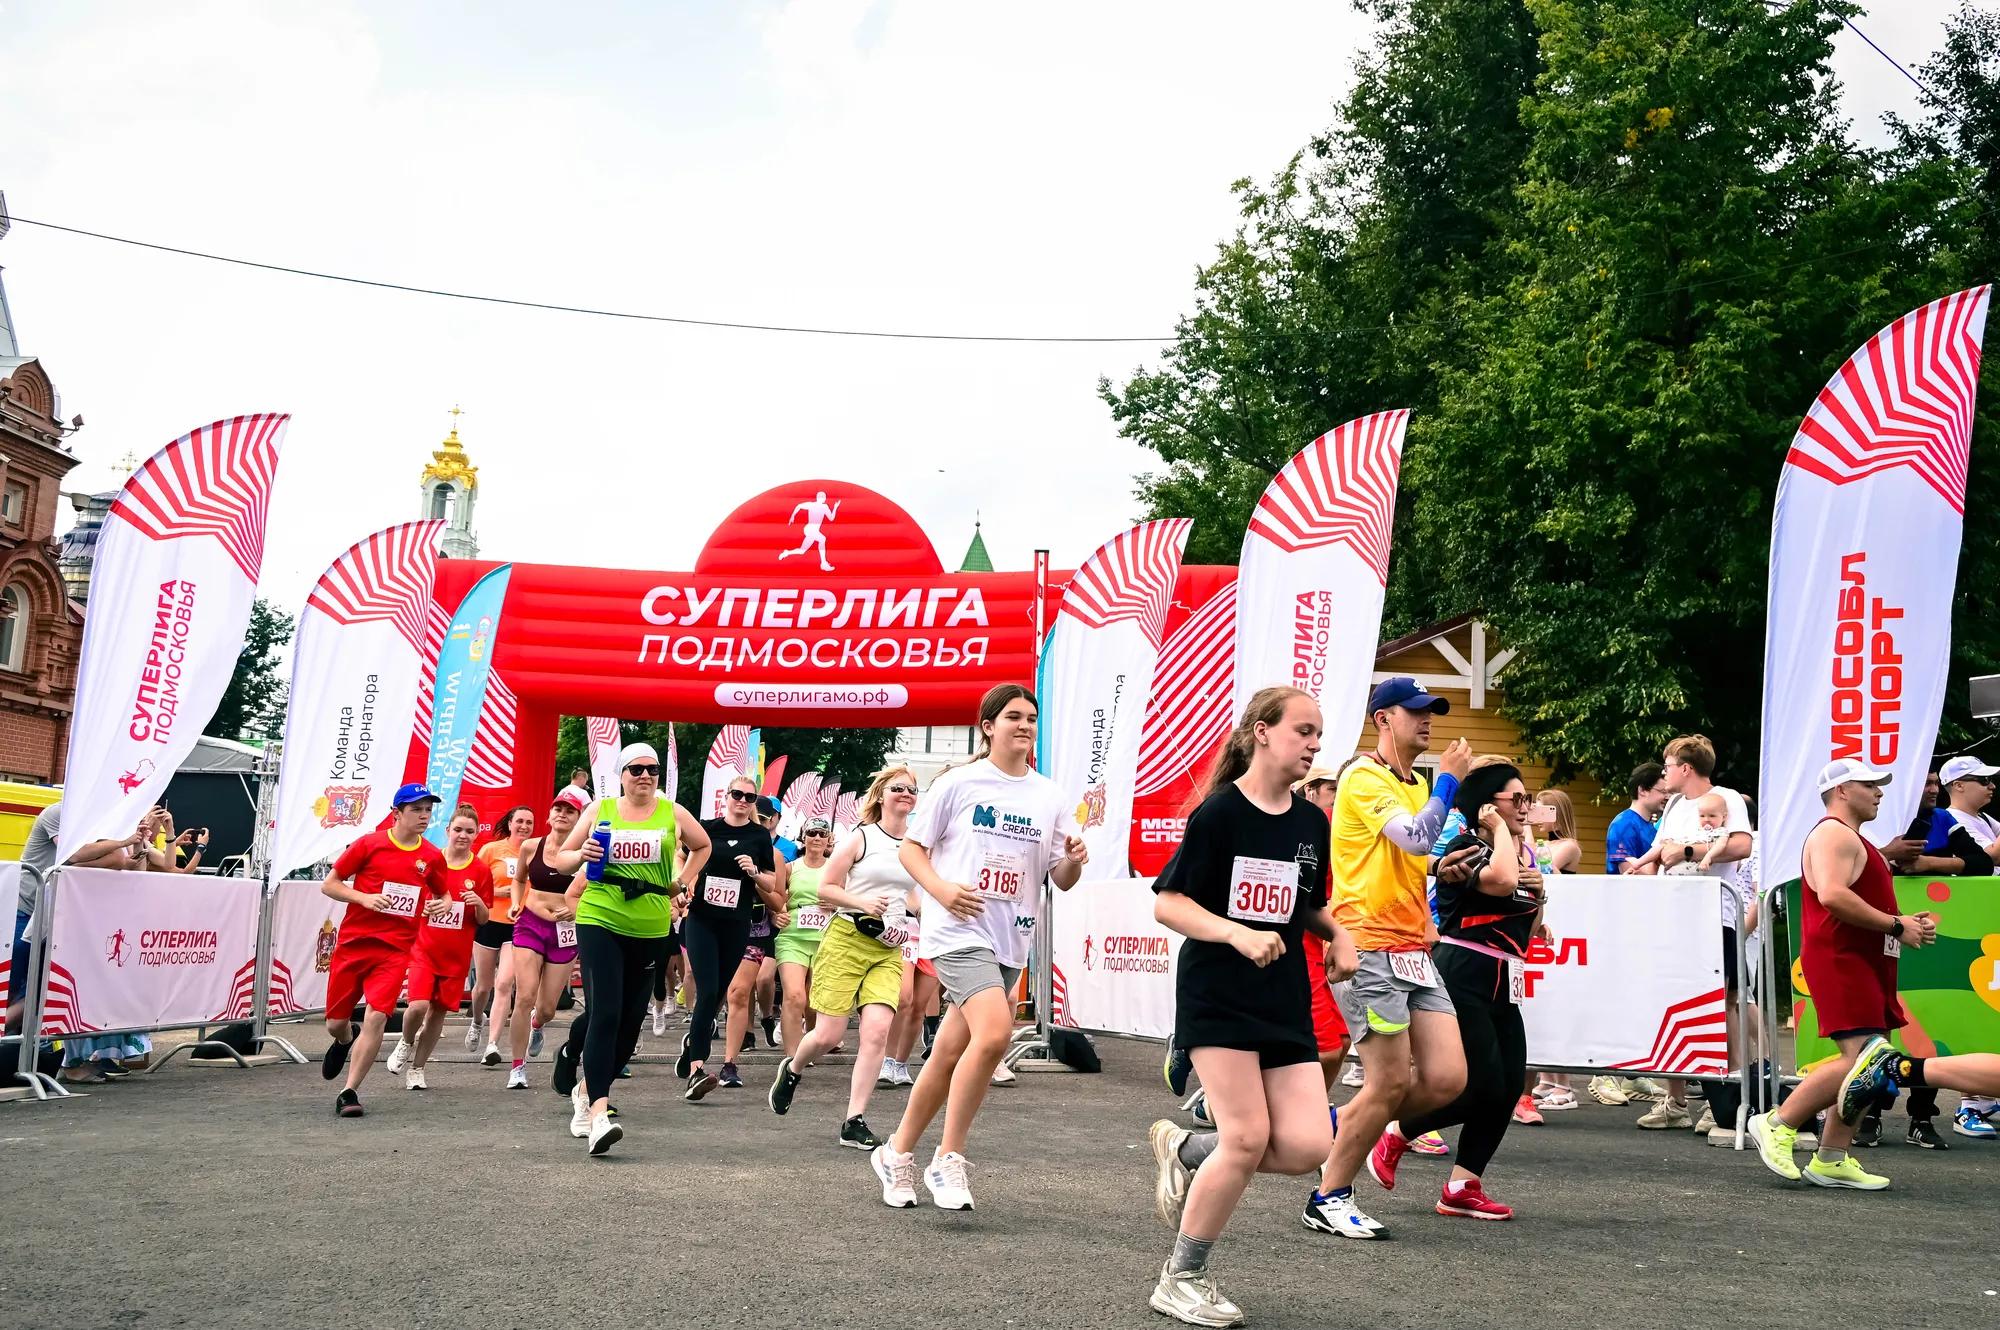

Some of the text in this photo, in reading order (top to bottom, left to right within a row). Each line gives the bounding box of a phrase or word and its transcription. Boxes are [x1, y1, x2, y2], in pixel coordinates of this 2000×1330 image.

[640, 585, 990, 629] СУПЕРЛИГА
[637, 633, 989, 672] ПОДМОСКОВЬЯ
[1310, 590, 1333, 704] МОСКОВЬЯ
[1830, 552, 1866, 762] МОСОБЛ
[129, 579, 177, 742] СУПЕРЛИГА
[153, 580, 197, 744] ПОДМОСКОВЬЯ
[1869, 597, 1904, 766] СПОРТ
[732, 687, 890, 707] суперлигамо.рф
[351, 674, 380, 780] Губернатора
[329, 706, 354, 780] Команда
[1087, 708, 1106, 784] Команда
[1002, 823, 1042, 838] CREATOR
[1003, 813, 1032, 827] MEME
[1140, 818, 1188, 830] МОС
[613, 841, 650, 859] 3060
[509, 863, 516, 875] 3
[979, 868, 1018, 895] 3185
[707, 887, 736, 904] 3212
[1237, 881, 1292, 915] 3050
[800, 914, 826, 927] 3232
[140, 929, 217, 949] СУПЕРЛИГА
[560, 929, 574, 944] 32
[1103, 935, 1169, 956] СУПЕРЛИГА
[138, 951, 216, 968] ПОДМОСКОВЬЯ
[1525, 938, 1588, 966] БЛ
[1103, 957, 1169, 974] ПОДМОСКОВЬЯ
[1391, 952, 1425, 981] 3015
[1513, 976, 1523, 998] 32
